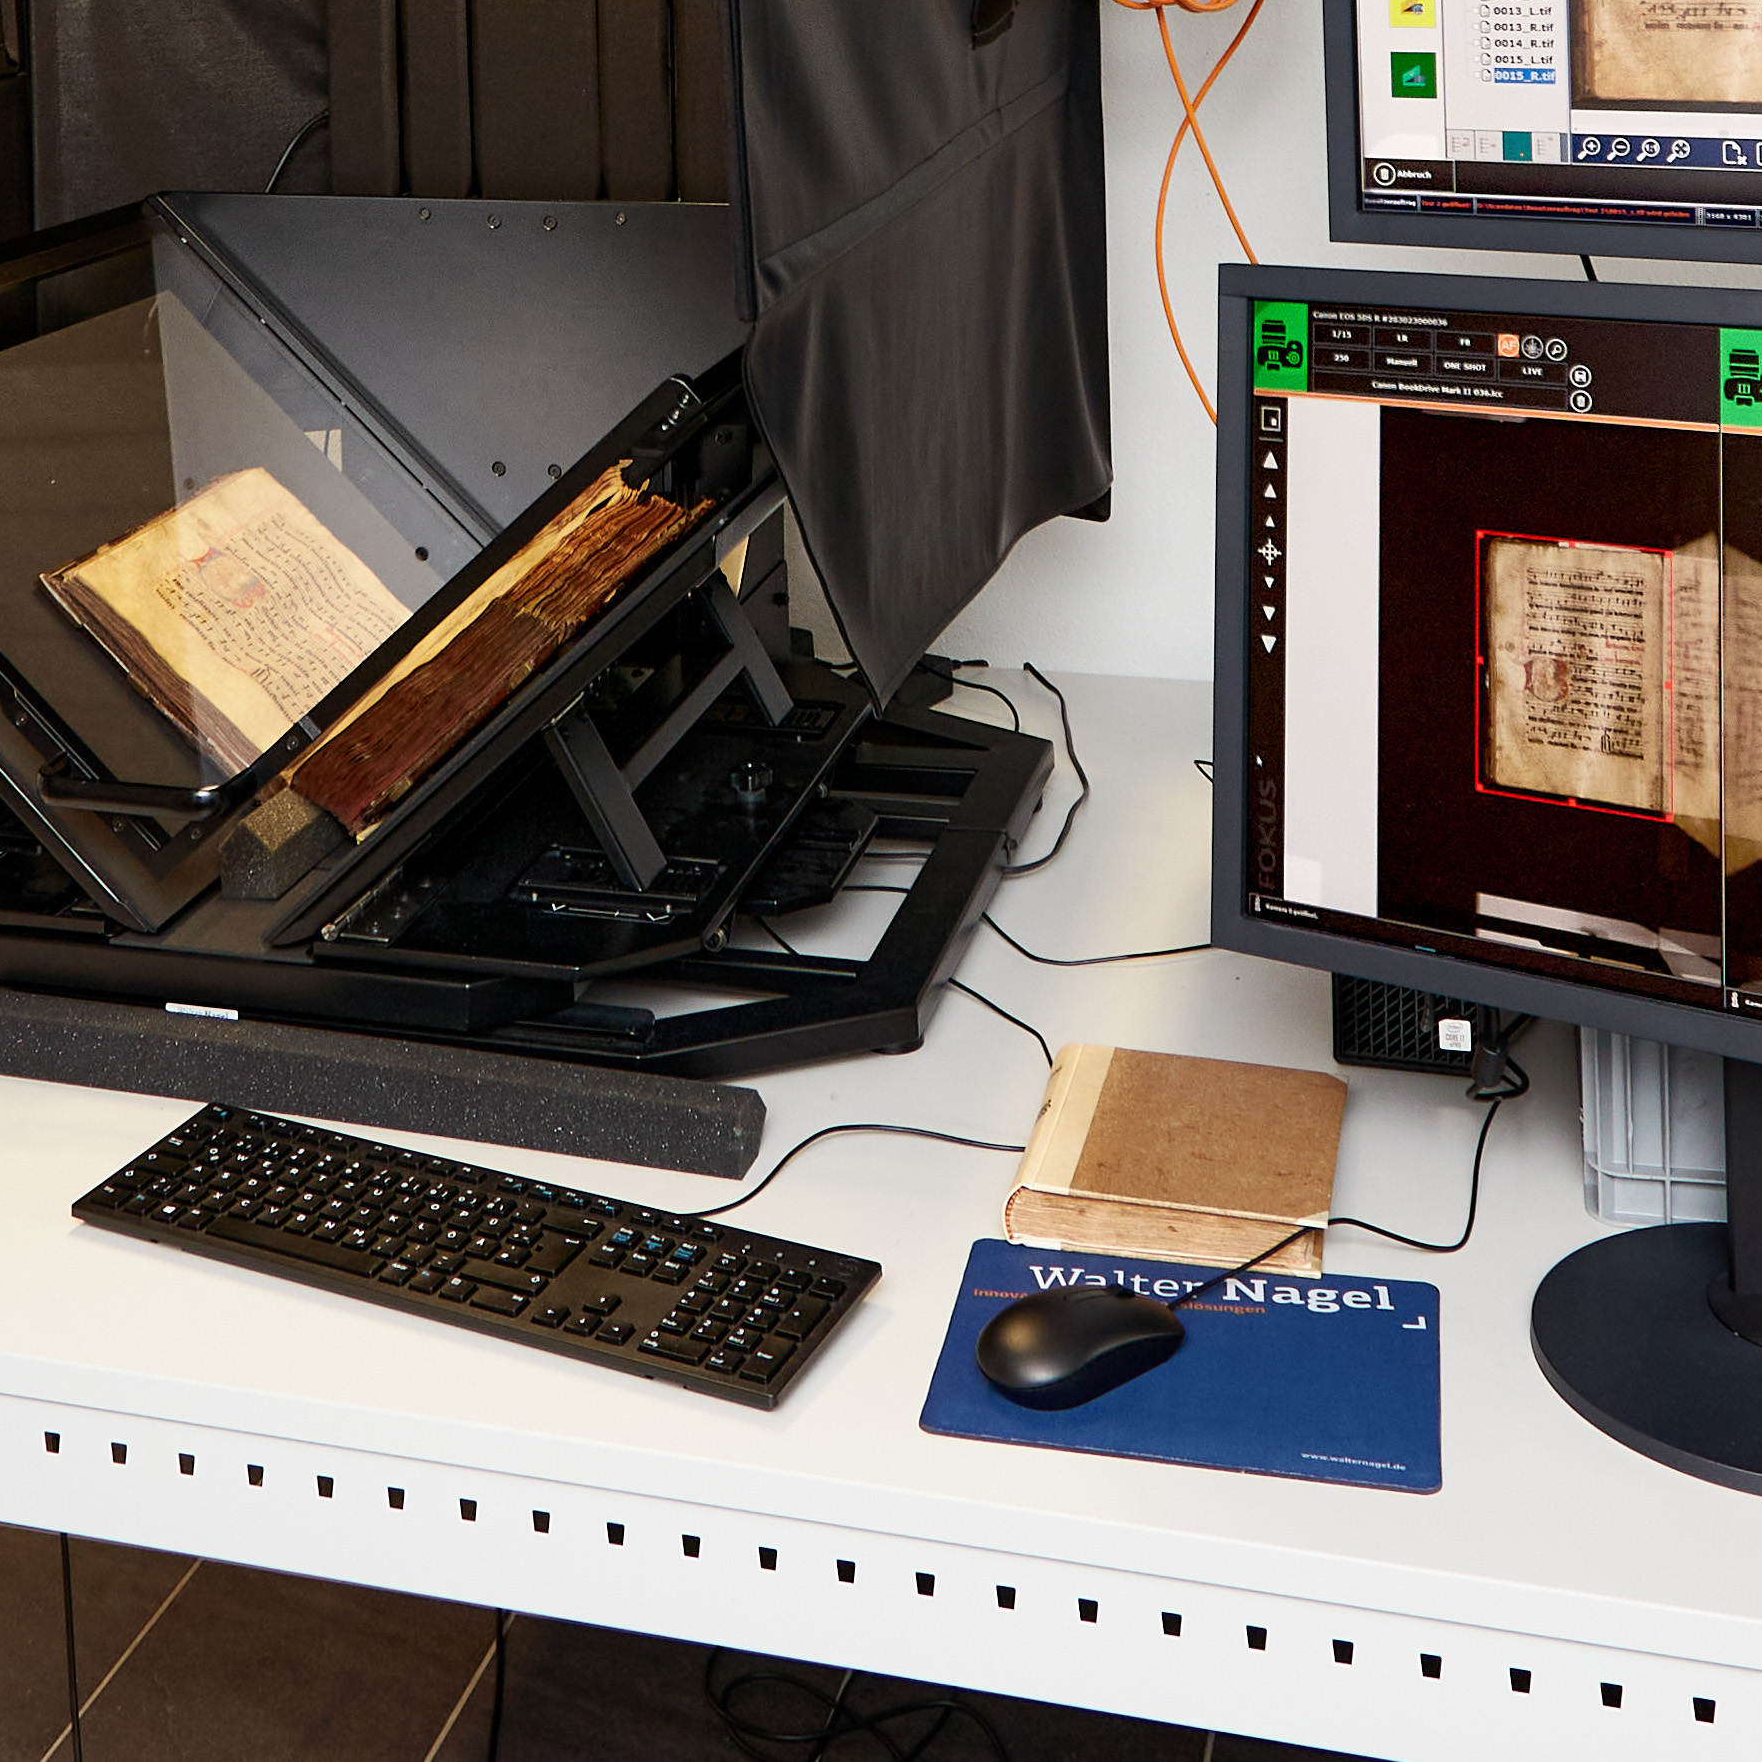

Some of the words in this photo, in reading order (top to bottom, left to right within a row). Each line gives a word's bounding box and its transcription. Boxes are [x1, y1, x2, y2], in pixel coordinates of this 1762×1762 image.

[1313, 310, 1337, 320] Canon
[1339, 312, 1355, 321] EOS
[1256, 776, 1278, 892] FOKUS
[1222, 1278, 1395, 1313] Nagel
[1301, 1452, 1406, 1471] www.walternagel.de
